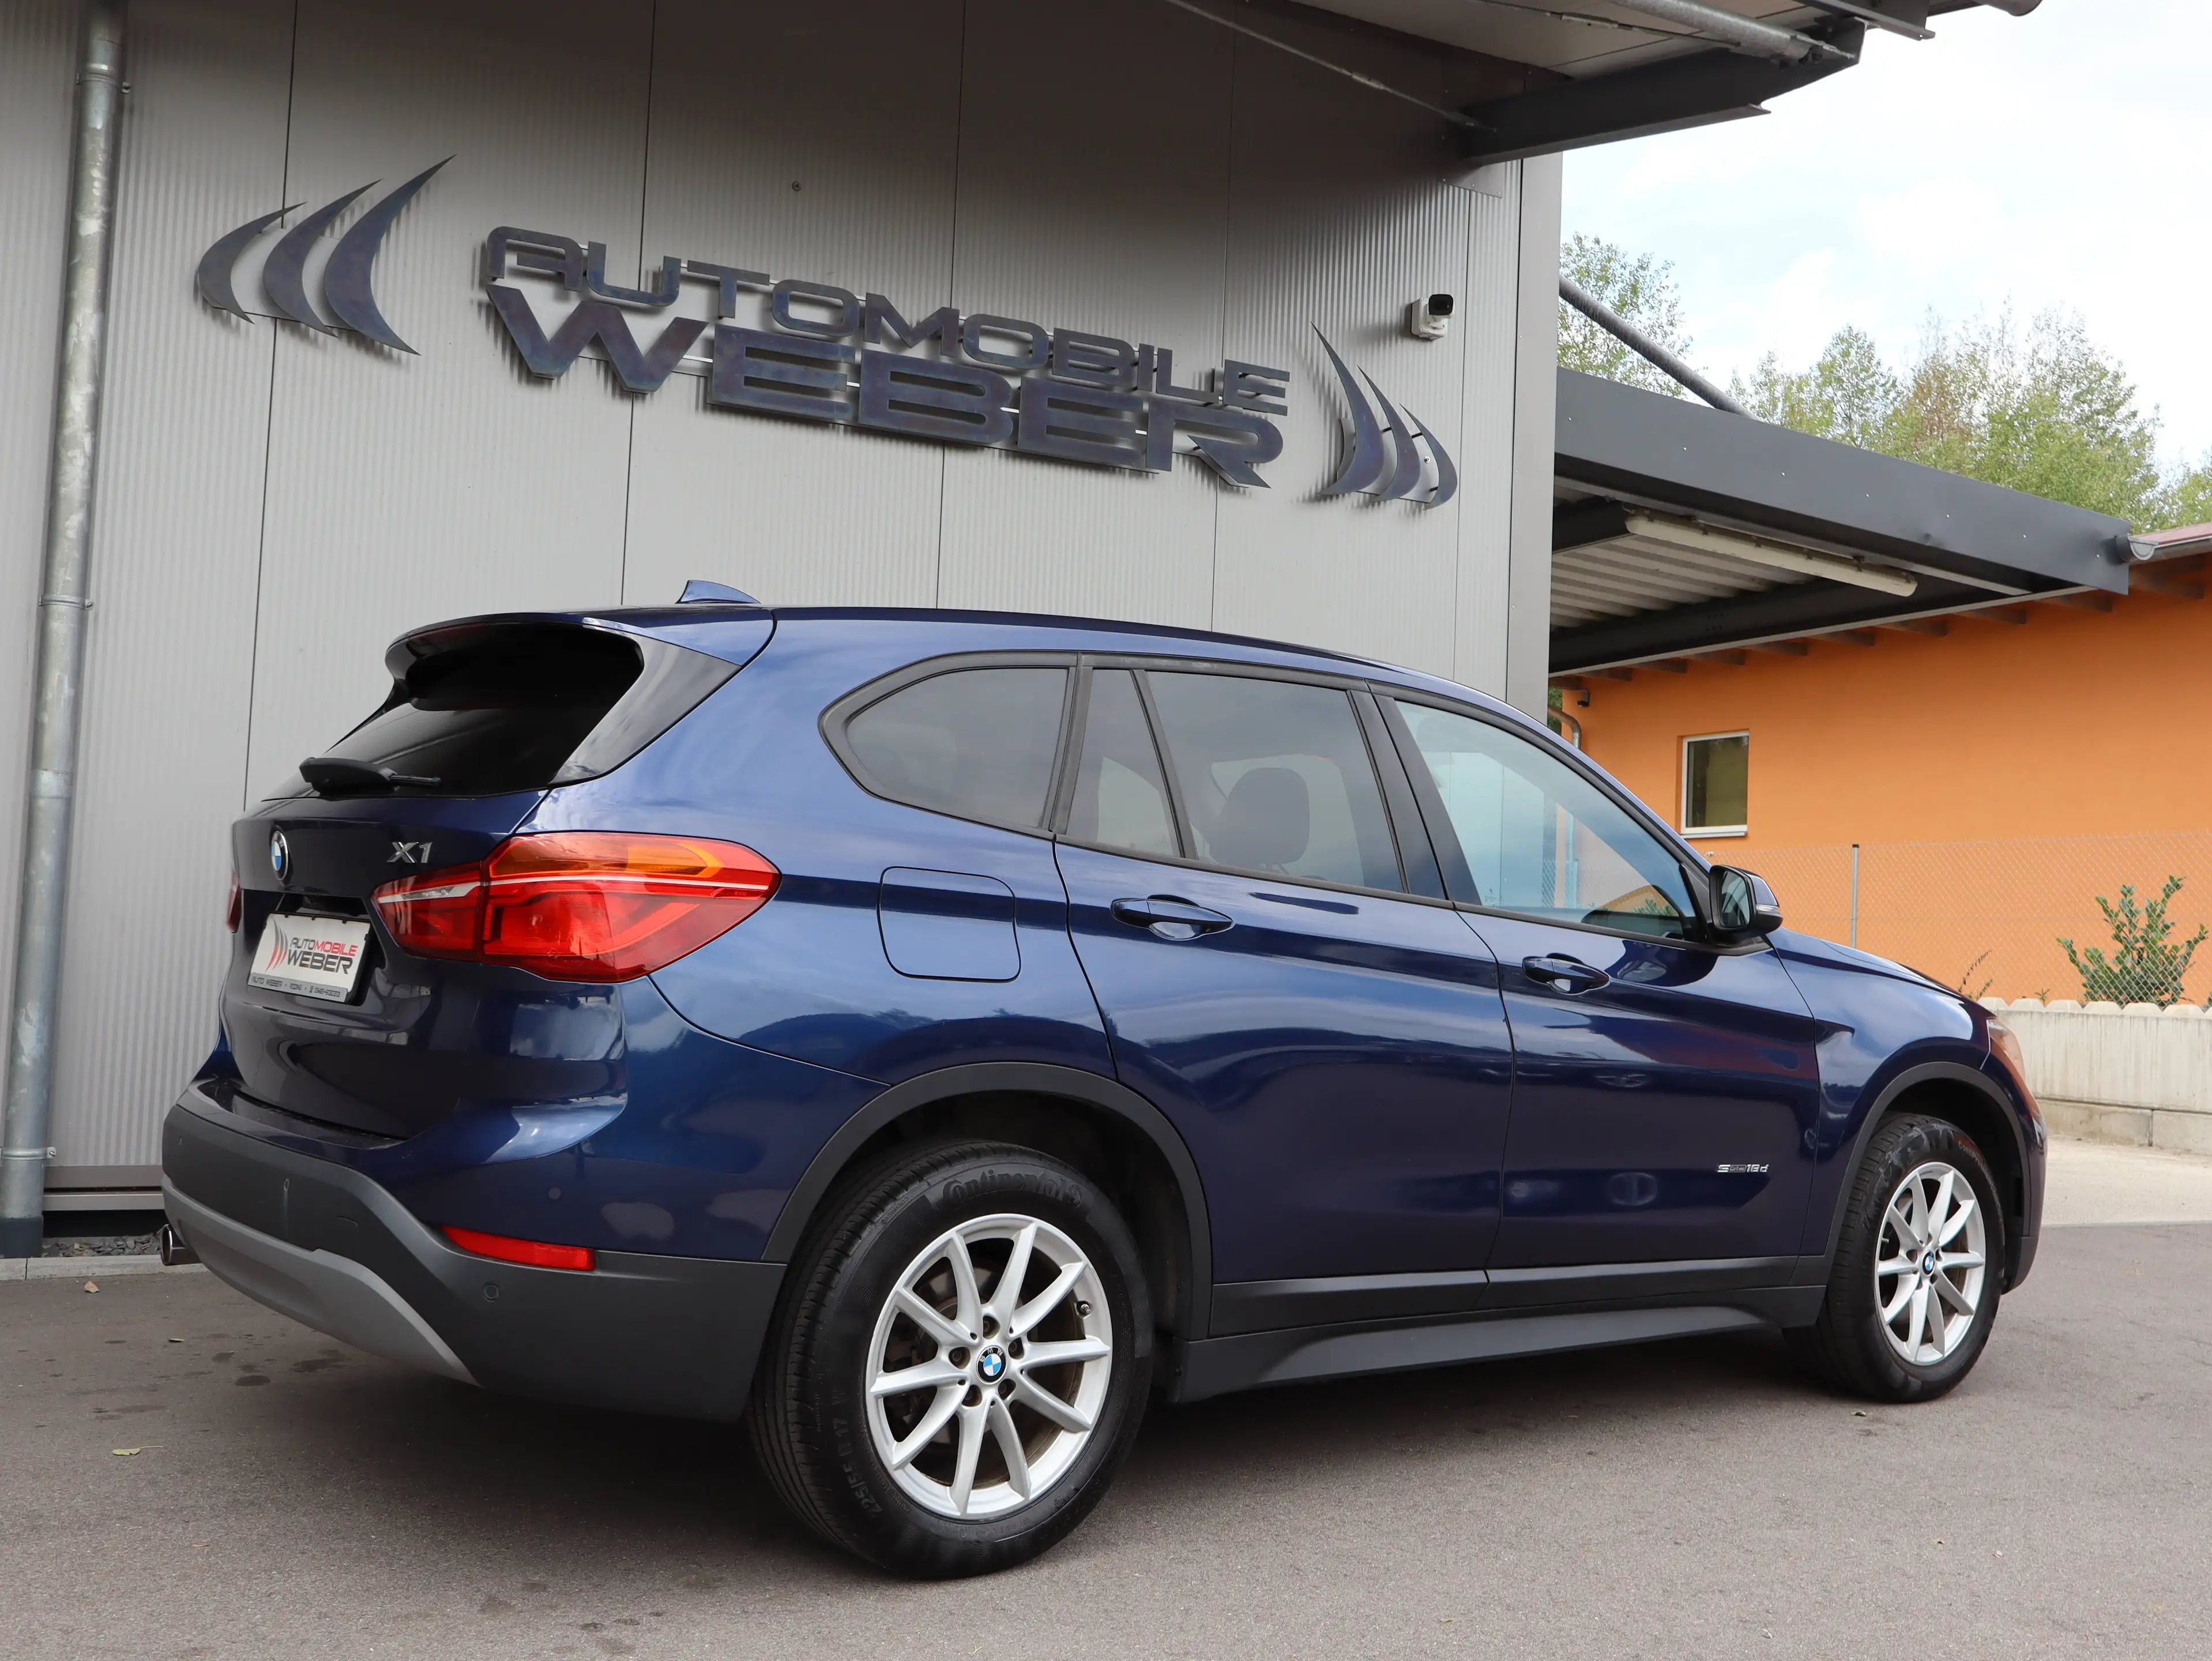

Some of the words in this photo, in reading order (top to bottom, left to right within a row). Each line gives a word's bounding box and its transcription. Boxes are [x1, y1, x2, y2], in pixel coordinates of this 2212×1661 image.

[487, 226, 1290, 416] AUTOMOBILE
[486, 283, 1284, 489] WEBER
[386, 841, 432, 863] X1
[288, 949, 353, 975] WEBER
[289, 937, 358, 956] AUTOMOBILE
[942, 1169, 1067, 1209] Continental
